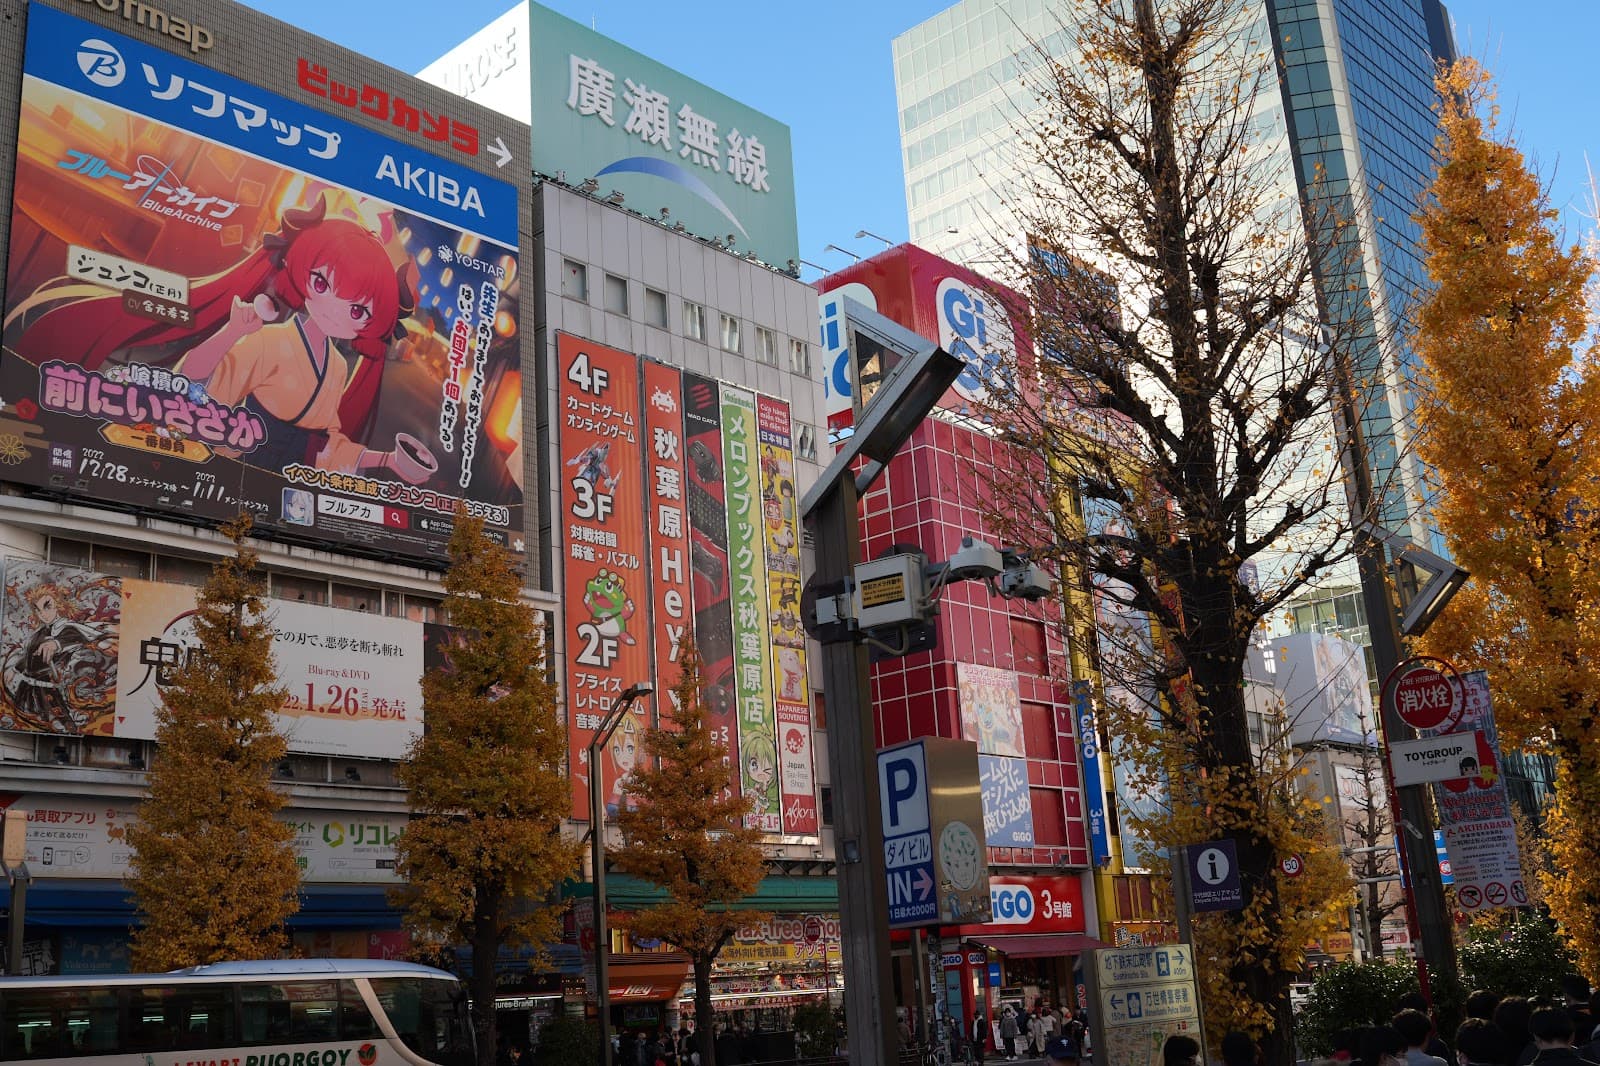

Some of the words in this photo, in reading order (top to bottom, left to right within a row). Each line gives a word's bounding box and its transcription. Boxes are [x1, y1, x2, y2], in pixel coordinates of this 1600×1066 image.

[79, 0, 214, 53] ofmap
[141, 62, 342, 160] ソフマップ
[297, 57, 479, 157] ビックカメラ
[566, 53, 770, 194] 廣瀬無線
[57, 149, 240, 219] ブルーアーカイブ
[375, 154, 486, 218] AKIBA
[142, 199, 222, 232] BlueArchive
[454, 251, 505, 278] YOSTAR
[943, 287, 986, 346] Gi
[568, 353, 609, 395] 4F
[567, 396, 634, 426] カードゲーム
[567, 414, 636, 443] オンラインゲーム
[130, 435, 186, 455] 一番勝負
[324, 499, 371, 519] ブルアカ
[571, 477, 613, 522] 3F
[570, 524, 617, 548] 対戦格闘
[571, 543, 640, 569] 麻雀・パズル
[729, 415, 763, 724] メロンブックス秋葉原店
[576, 624, 619, 667] 2F
[308, 664, 340, 678] Blu-ray
[350, 671, 370, 681] DVD
[575, 672, 622, 693] プライズ
[1401, 677, 1415, 687] FIRE
[372, 697, 406, 721] 発売
[778, 704, 808, 714] JAPANESE
[1400, 684, 1450, 713] 消火栓
[778, 712, 808, 723] SOUVENIR
[1404, 746, 1463, 762] TOYGROUP
[886, 758, 917, 827] P
[1012, 831, 1032, 842] GiGO
[1457, 820, 1512, 833] AKIHABARA
[887, 839, 929, 865] ダイビル
[1284, 859, 1298, 871] 50
[886, 870, 913, 905] IN
[1041, 889, 1072, 919] 3号館
